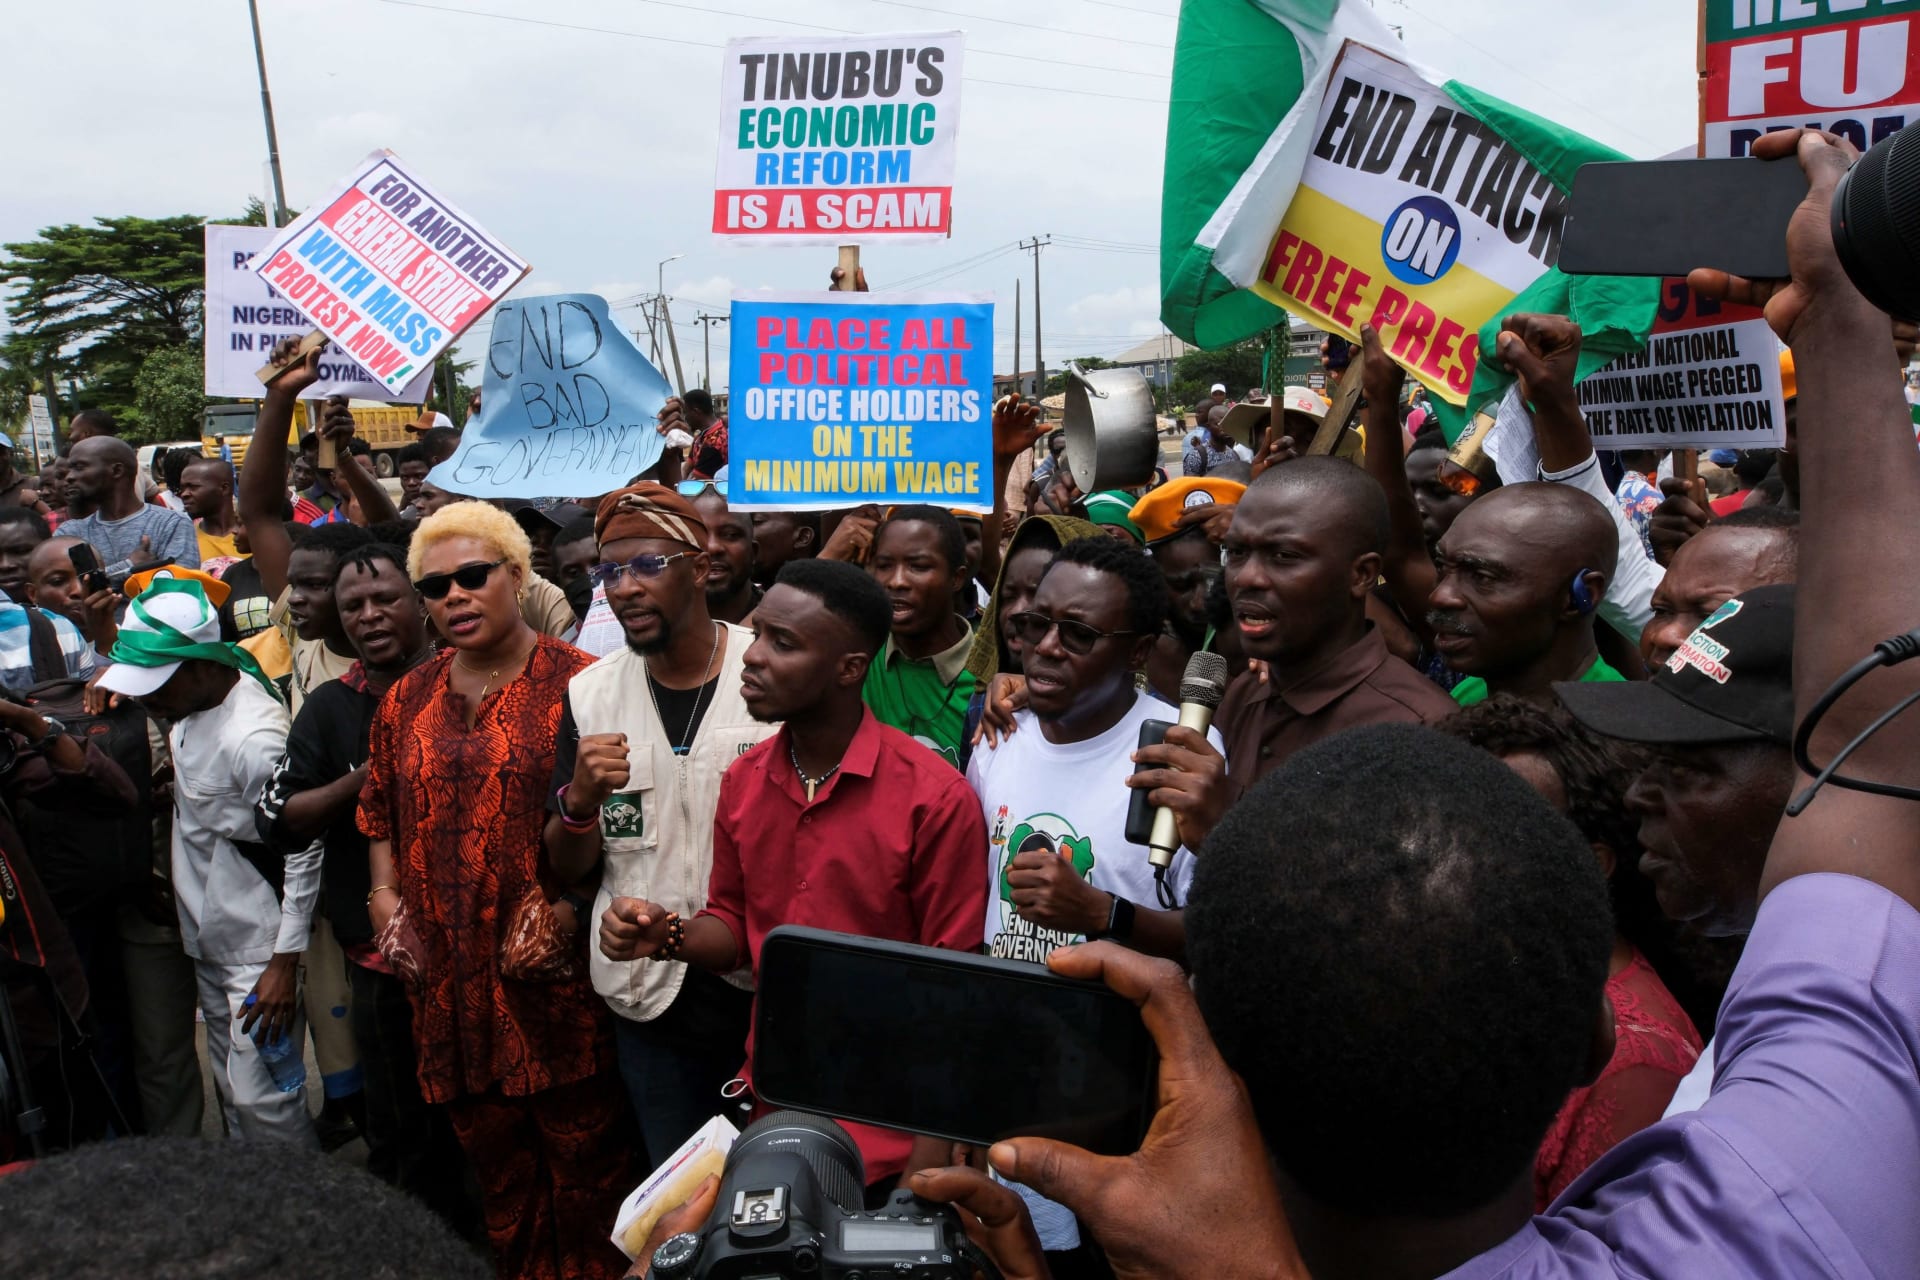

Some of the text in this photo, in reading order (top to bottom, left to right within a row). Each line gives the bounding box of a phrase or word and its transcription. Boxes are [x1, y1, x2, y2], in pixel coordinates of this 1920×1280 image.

[739, 46, 945, 102] TINUBU'S
[1728, 20, 1909, 117] FU
[738, 102, 936, 149] ECONOMIC
[1313, 76, 1417, 175] END
[755, 149, 912, 185] REFORM
[727, 192, 942, 229] IS A SCAM
[369, 174, 509, 292] FOR ANOTHER
[1385, 207, 1456, 279] ON
[333, 199, 484, 326] GENERAL STRIKE
[297, 228, 442, 357] WITH MASS
[232, 306, 318, 327] NIGERI
[263, 249, 414, 385] PROTEST NOW!
[1263, 229, 1479, 395] FREE PRES
[230, 334, 253, 351] IN
[489, 301, 602, 379] END
[756, 317, 972, 350] PLACE ALL
[1654, 328, 1739, 367] NATIONAL
[759, 353, 969, 386] POLITICAL
[1576, 363, 1762, 406] INIMUM WAGE PEGGED
[520, 374, 610, 430] BAD
[745, 387, 980, 422] OFFICE HOLDERS
[1584, 400, 1773, 435] THE RATE OF INFLATION
[812, 425, 913, 457] ON THE
[744, 460, 979, 494] MINIMUM WAGE
[1680, 643, 1728, 681] RMATION
[1007, 913, 1034, 936] END
[992, 933, 1060, 966] GOVERNA
[768, 1138, 801, 1146] Canon
